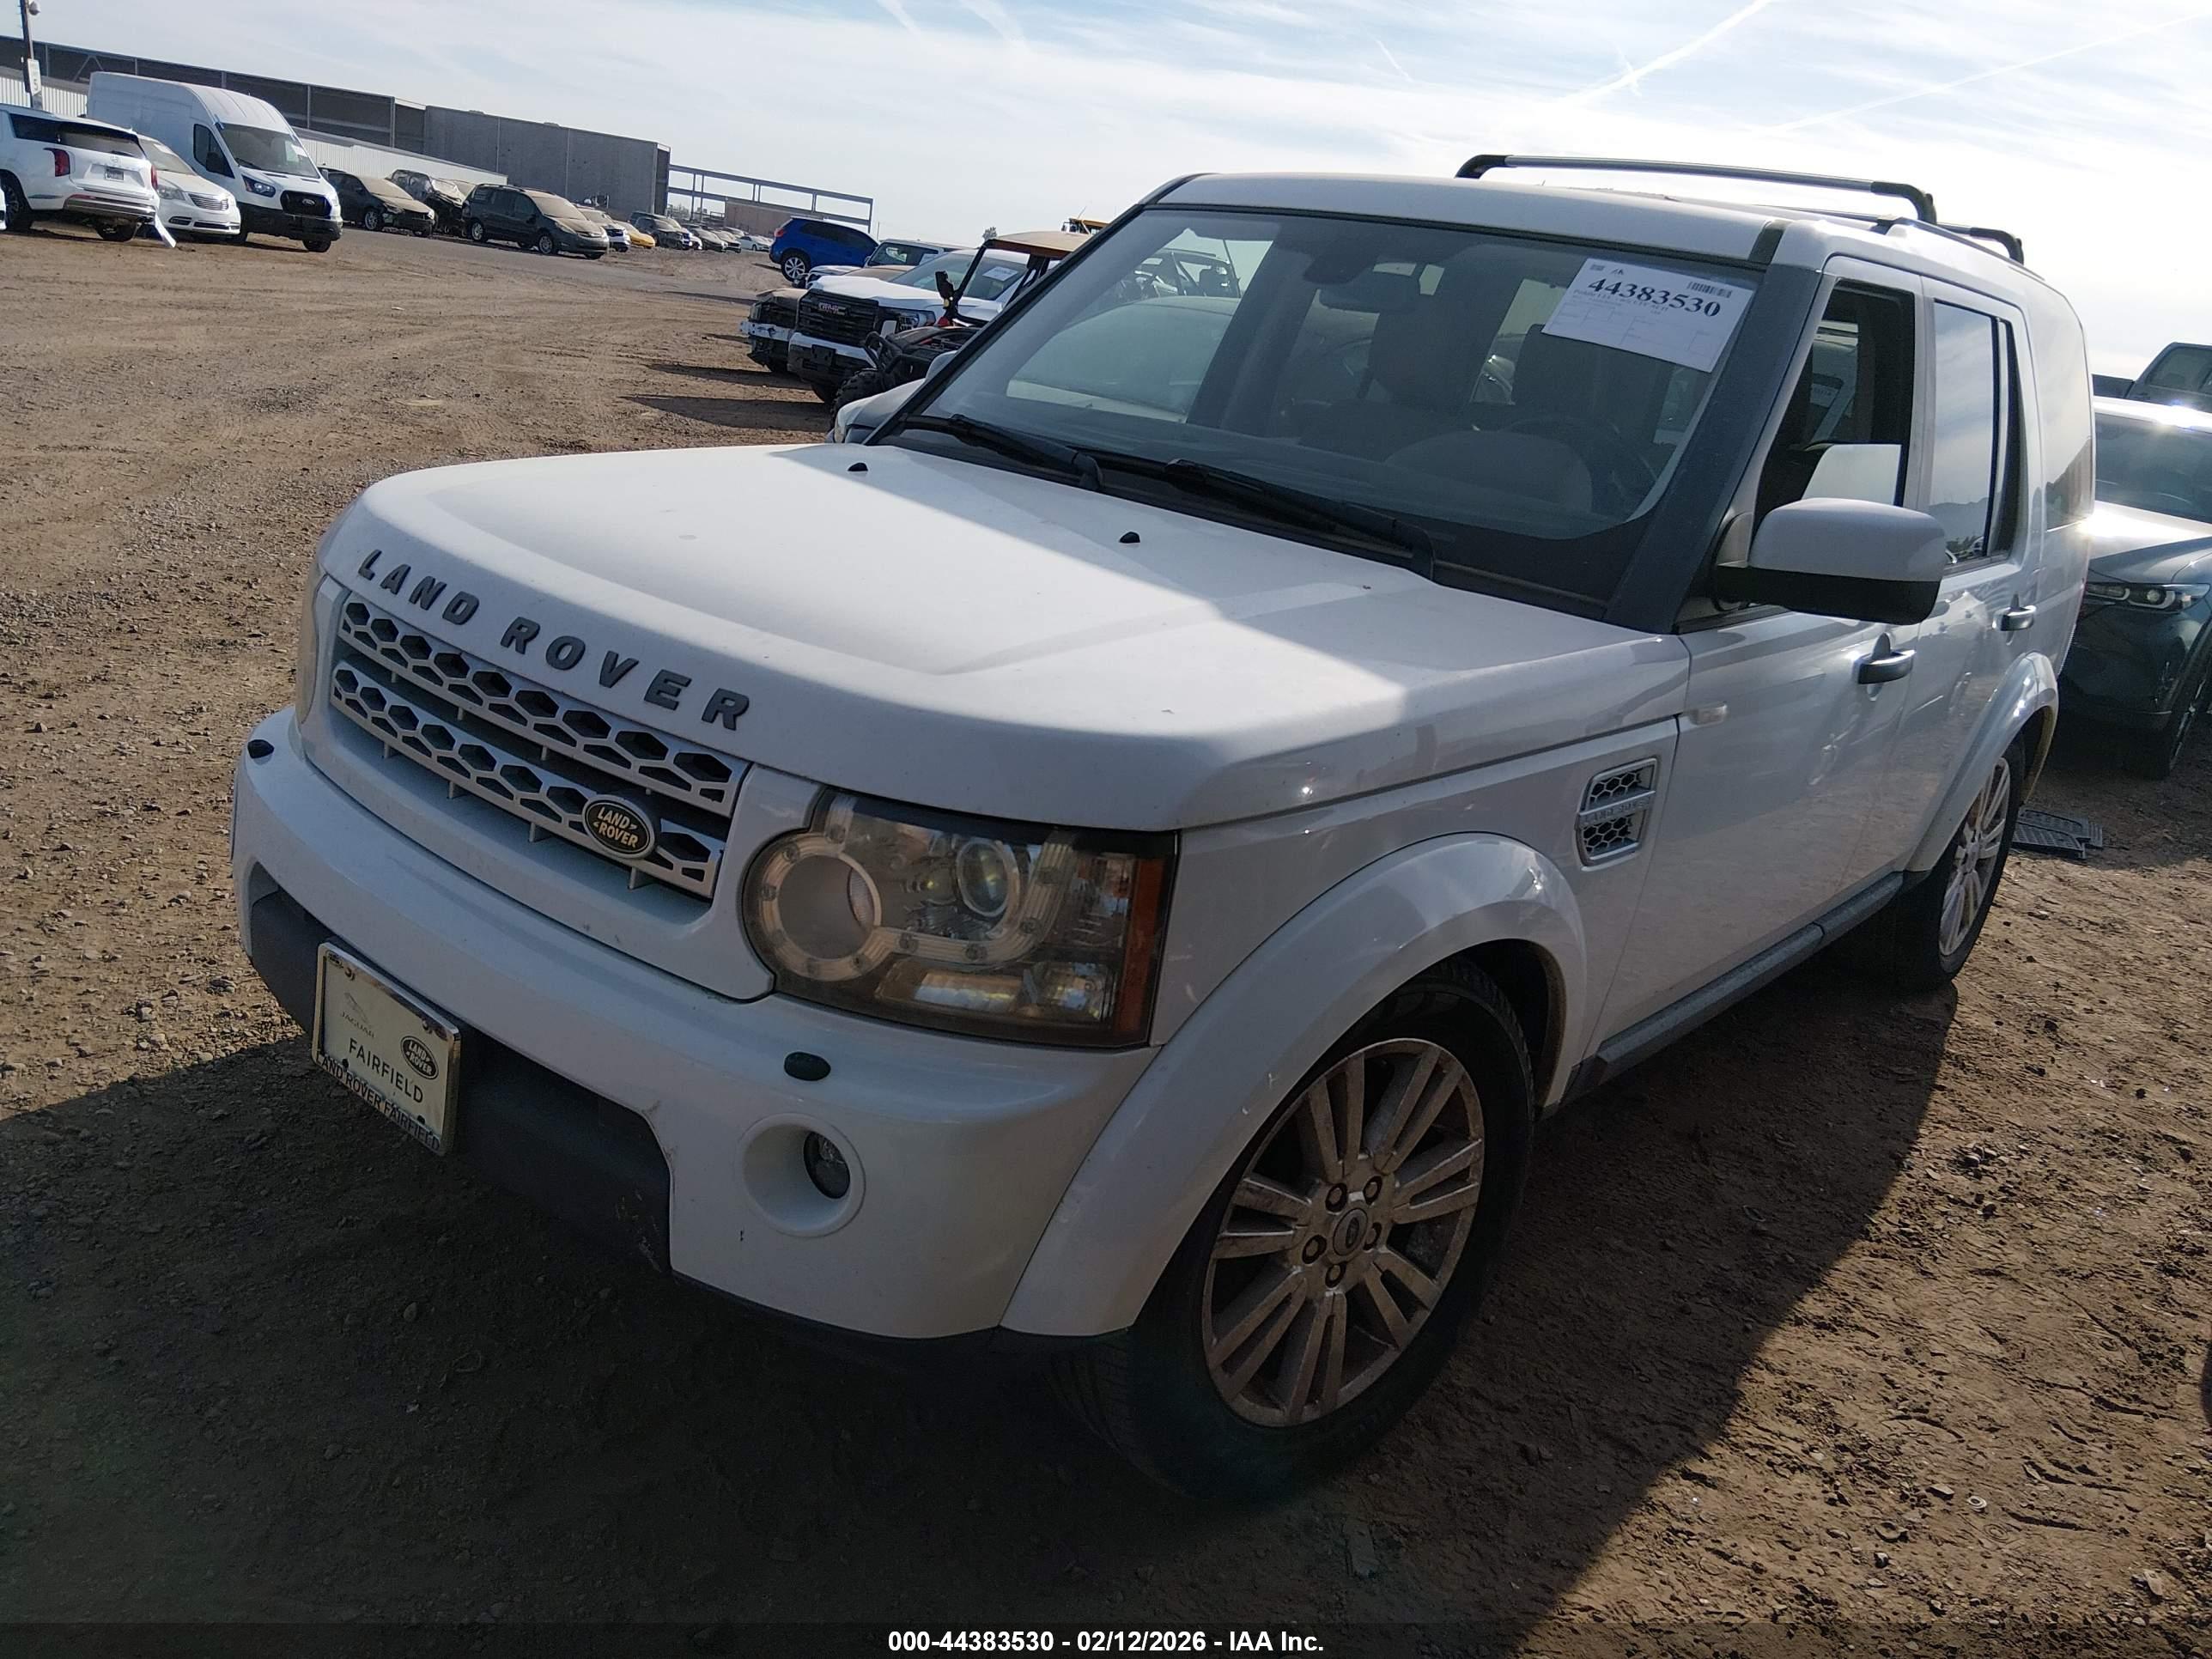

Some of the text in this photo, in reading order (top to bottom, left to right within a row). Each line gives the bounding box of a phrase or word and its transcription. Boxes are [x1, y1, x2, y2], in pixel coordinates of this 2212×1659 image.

[1588, 278, 1721, 317] 44383530
[358, 550, 750, 732] LAND ROVER
[597, 806, 630, 830] LAND
[599, 822, 639, 848] ROVER
[409, 1041, 427, 1060] LAND
[410, 1052, 433, 1075] ROVER
[349, 1037, 423, 1103] FAIRFIELD
[315, 1051, 441, 1151] LAND ROVER FAIRFIELD
